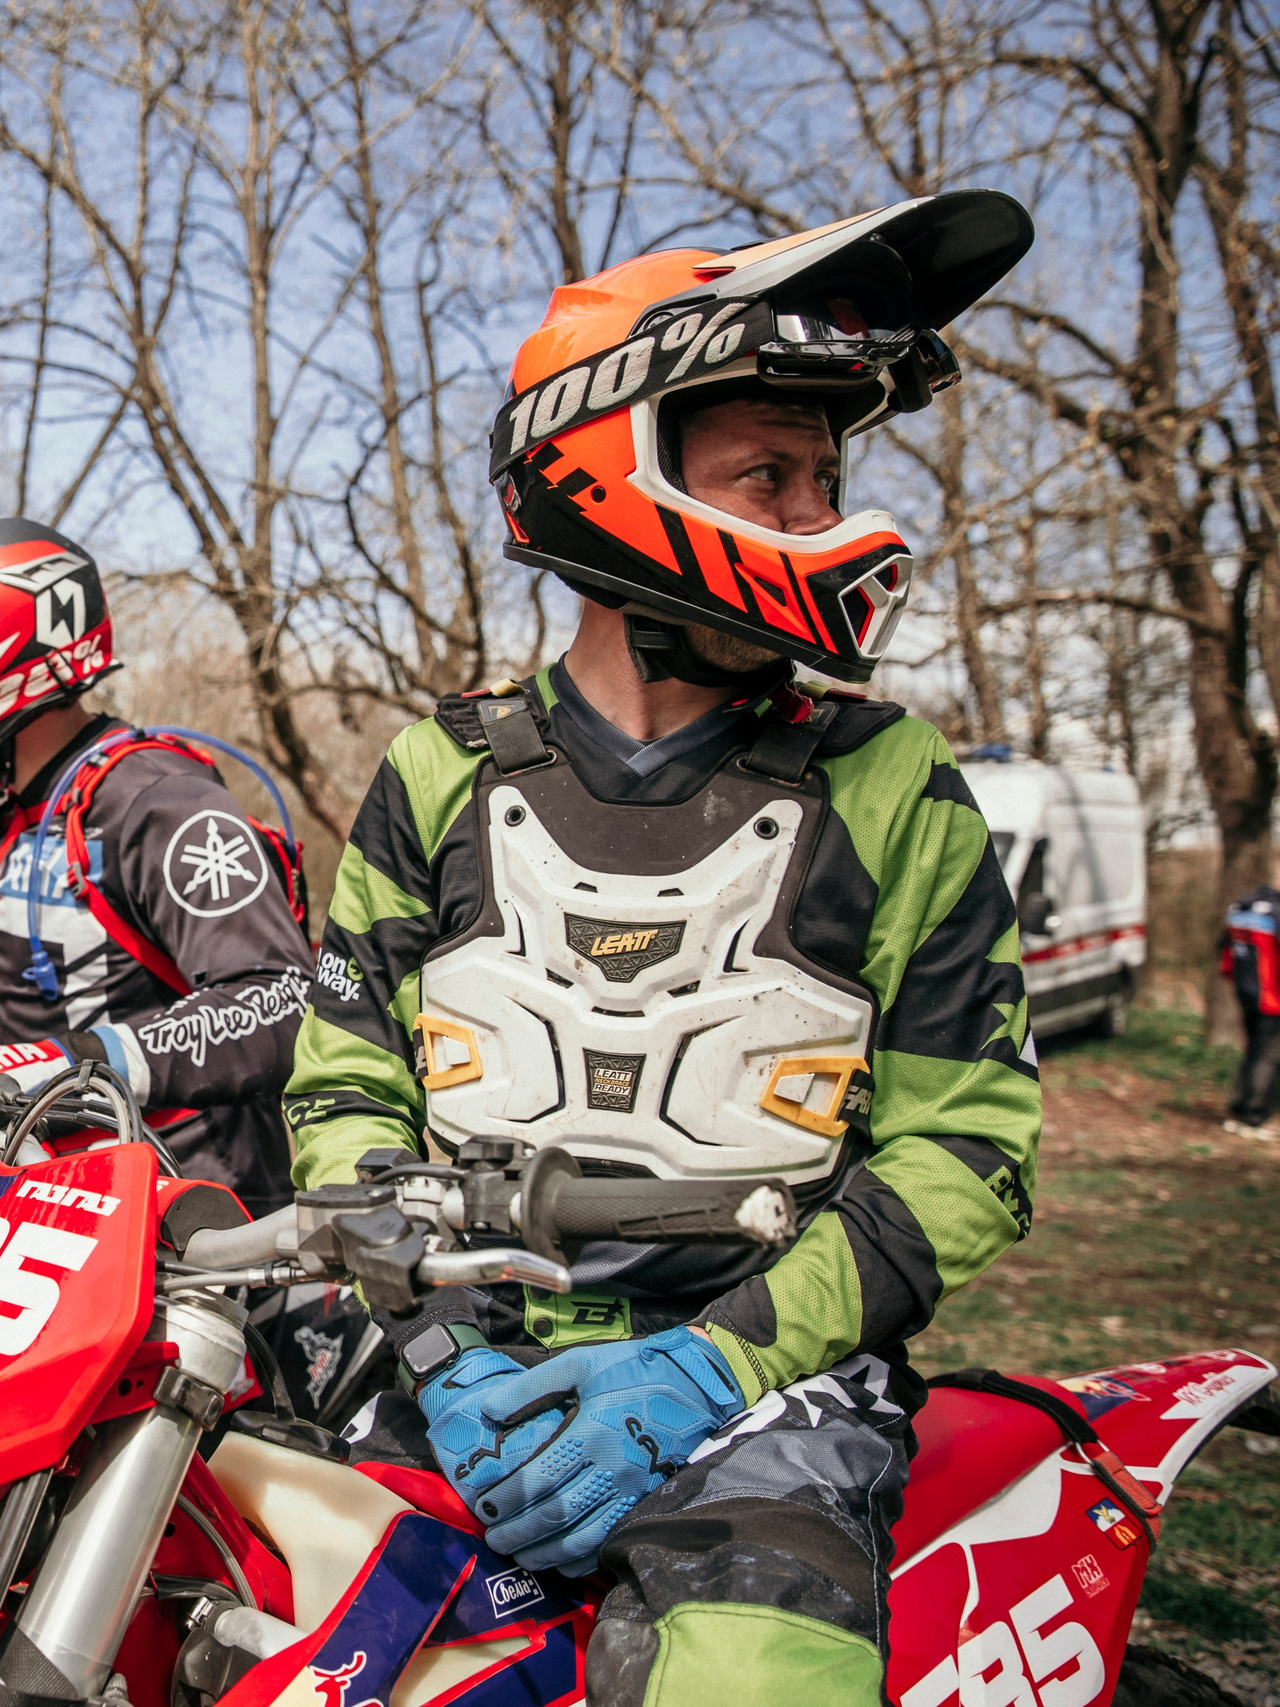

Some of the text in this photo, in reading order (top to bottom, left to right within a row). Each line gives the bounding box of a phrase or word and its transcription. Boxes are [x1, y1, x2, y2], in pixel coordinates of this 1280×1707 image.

[508, 302, 748, 455] 100%
[590, 929, 660, 957] LEATT
[316, 965, 361, 1002] way.
[594, 1083, 630, 1095] READY
[595, 1069, 631, 1081] LEATT
